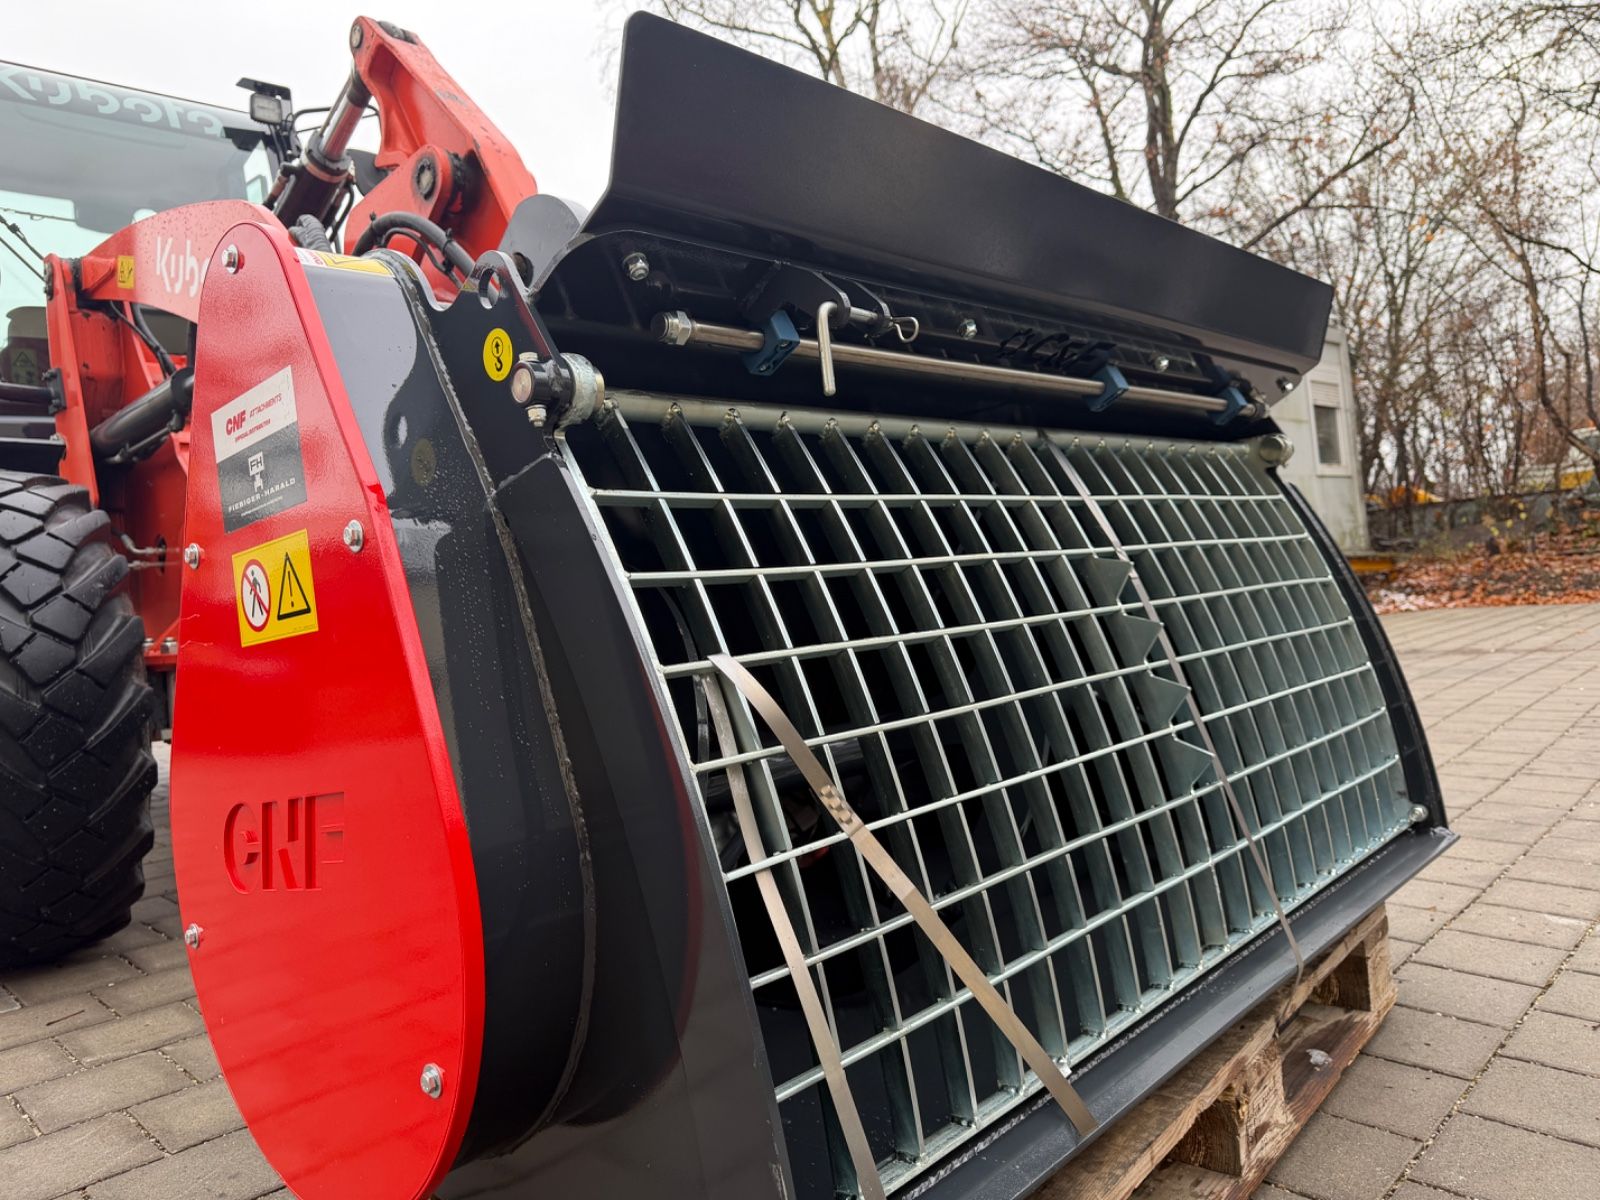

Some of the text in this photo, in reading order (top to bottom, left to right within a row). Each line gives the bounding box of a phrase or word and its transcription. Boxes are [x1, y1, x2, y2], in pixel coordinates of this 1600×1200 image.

[226, 393, 282, 436] CNF ATTACHMENTS
[250, 455, 263, 472] FH
[223, 791, 345, 896] CNF
